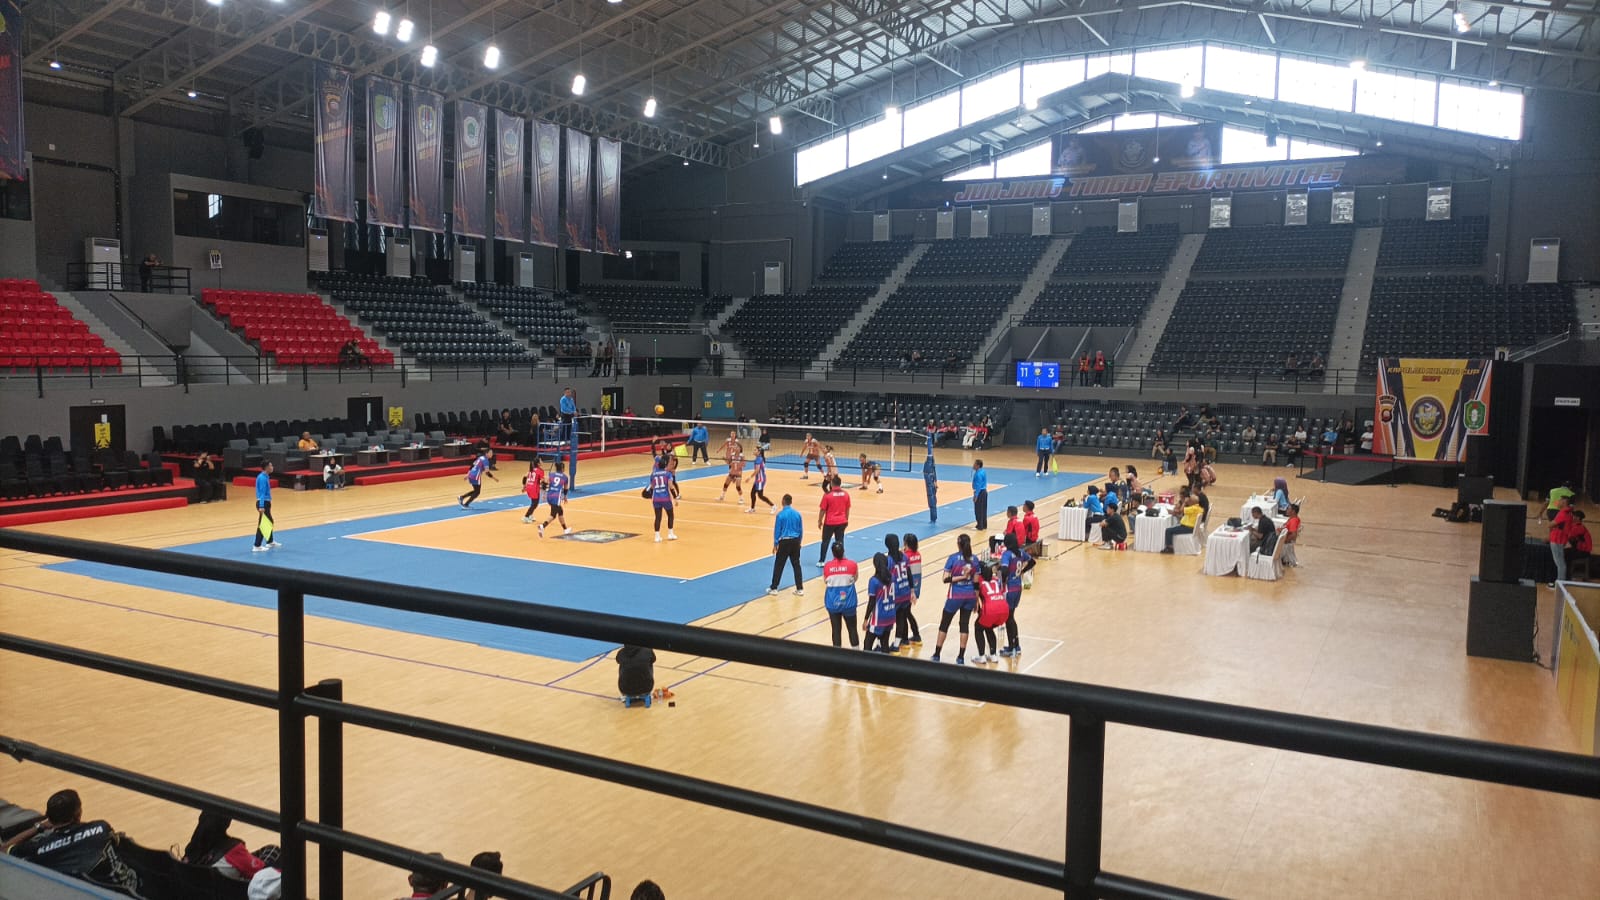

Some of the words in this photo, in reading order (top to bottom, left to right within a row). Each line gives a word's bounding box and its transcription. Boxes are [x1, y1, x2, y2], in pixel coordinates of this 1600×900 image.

[955, 178, 1065, 202] JUNJUNG
[1068, 173, 1153, 196] TINGGI
[1153, 162, 1344, 192] SPORTIVITAS
[1020, 367, 1028, 377] 11
[1048, 368, 1055, 378] 3
[553, 476, 561, 487] 9
[654, 475, 666, 489] 11
[894, 562, 908, 582] 15
[1015, 560, 1022, 577] 8
[882, 581, 896, 604] 14
[982, 579, 1000, 595] 17
[73, 825, 104, 843] RAYA
